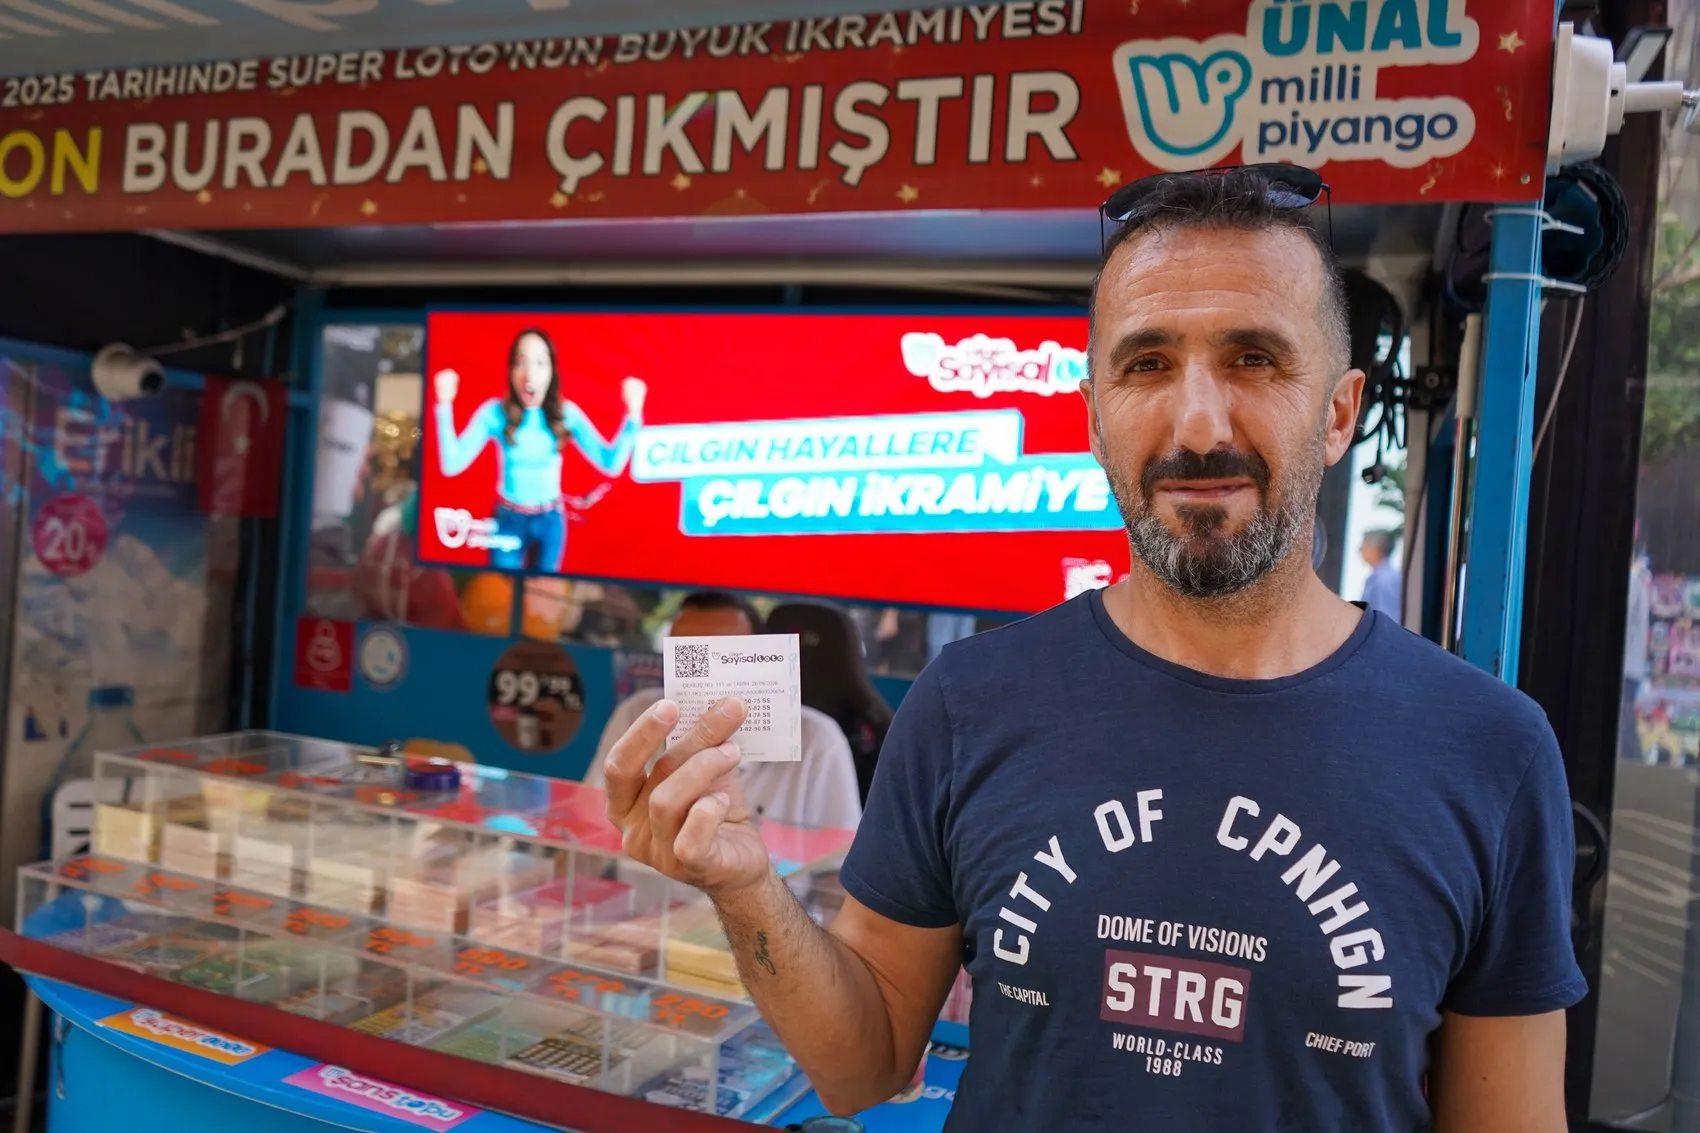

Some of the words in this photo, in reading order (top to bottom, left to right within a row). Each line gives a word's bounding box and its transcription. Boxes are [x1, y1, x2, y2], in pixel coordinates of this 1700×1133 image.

[1262, 0, 1462, 57] ÜNAL
[3, 75, 75, 107] 2025
[1260, 64, 1361, 106] milli
[122, 102, 515, 194] BURADAN
[546, 71, 1081, 195] ÇIKMIŞTIR
[1258, 110, 1458, 155] piyango
[766, 429, 980, 461] HAYALLERE
[496, 671, 540, 706] 99
[993, 835, 1077, 965] CITY
[1094, 788, 1163, 853] OF
[1216, 795, 1393, 1009] CPNHGN
[1097, 914, 1154, 943] DOME
[1157, 921, 1183, 947] OF
[1187, 925, 1268, 963] VISIONS
[998, 982, 1014, 1000] THE
[1012, 985, 1050, 1006] CAPITAL
[1105, 962, 1244, 1029] STRG
[1112, 1032, 1223, 1065] WORLD-CLASS
[1305, 1032, 1344, 1053] CHIEF
[1344, 1040, 1376, 1059] PORT
[1145, 1057, 1182, 1077] 1988
